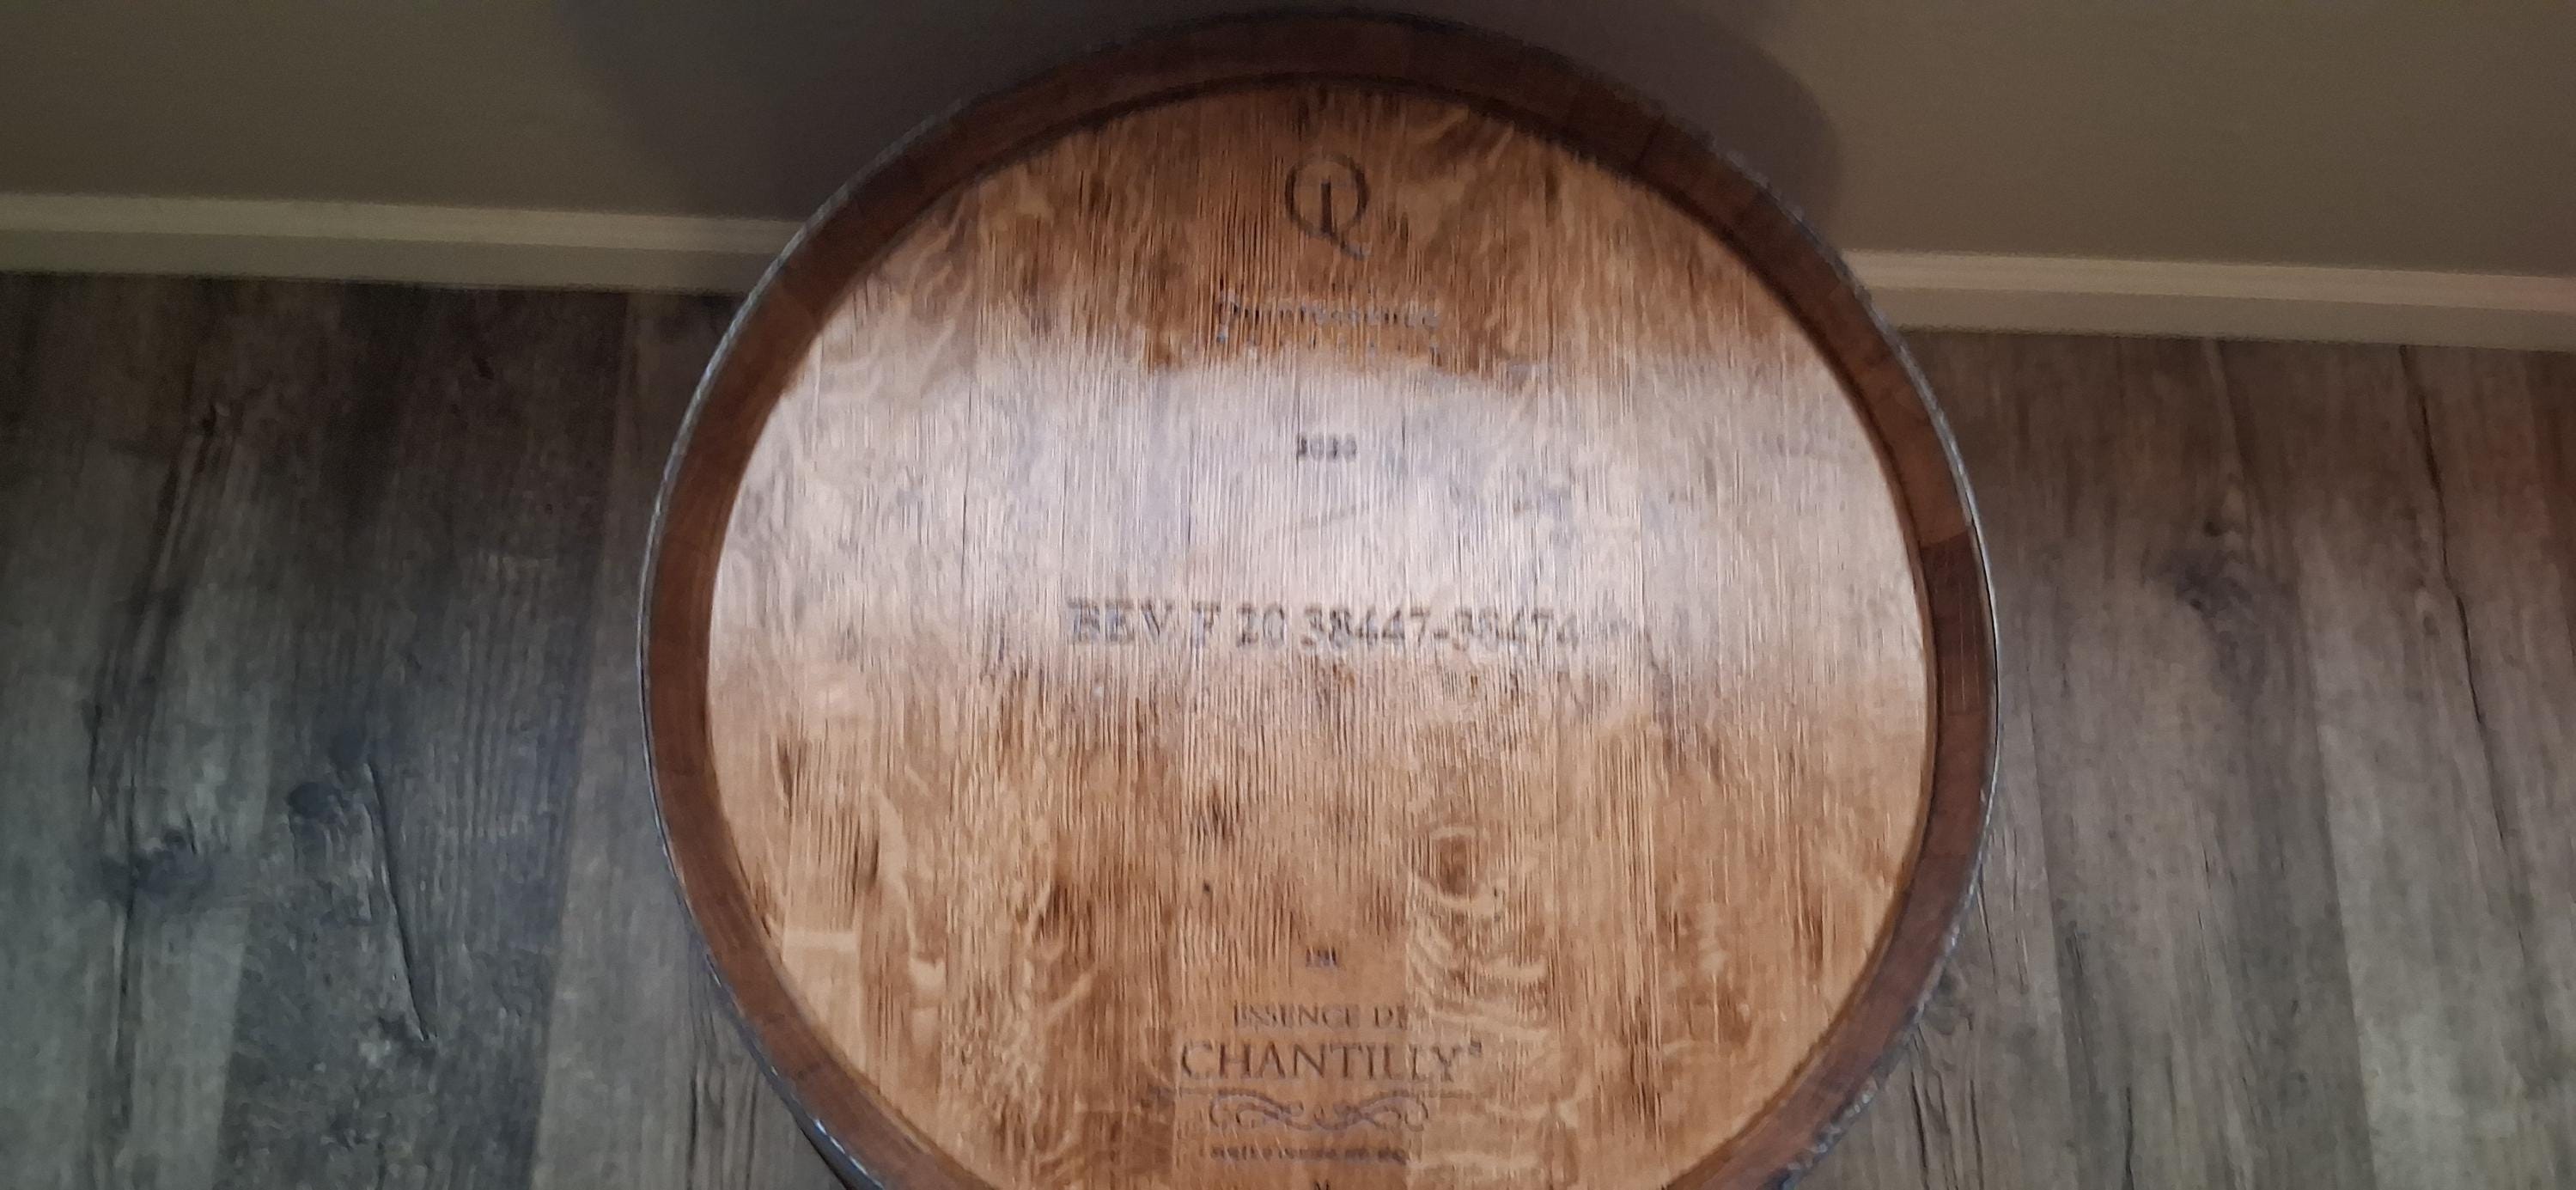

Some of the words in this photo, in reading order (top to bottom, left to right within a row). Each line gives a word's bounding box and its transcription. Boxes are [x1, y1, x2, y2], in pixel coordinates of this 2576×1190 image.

[1068, 599, 1175, 644] BEV
[1236, 601, 1286, 649] 20
[1233, 1004, 1361, 1030] ESSENCE
